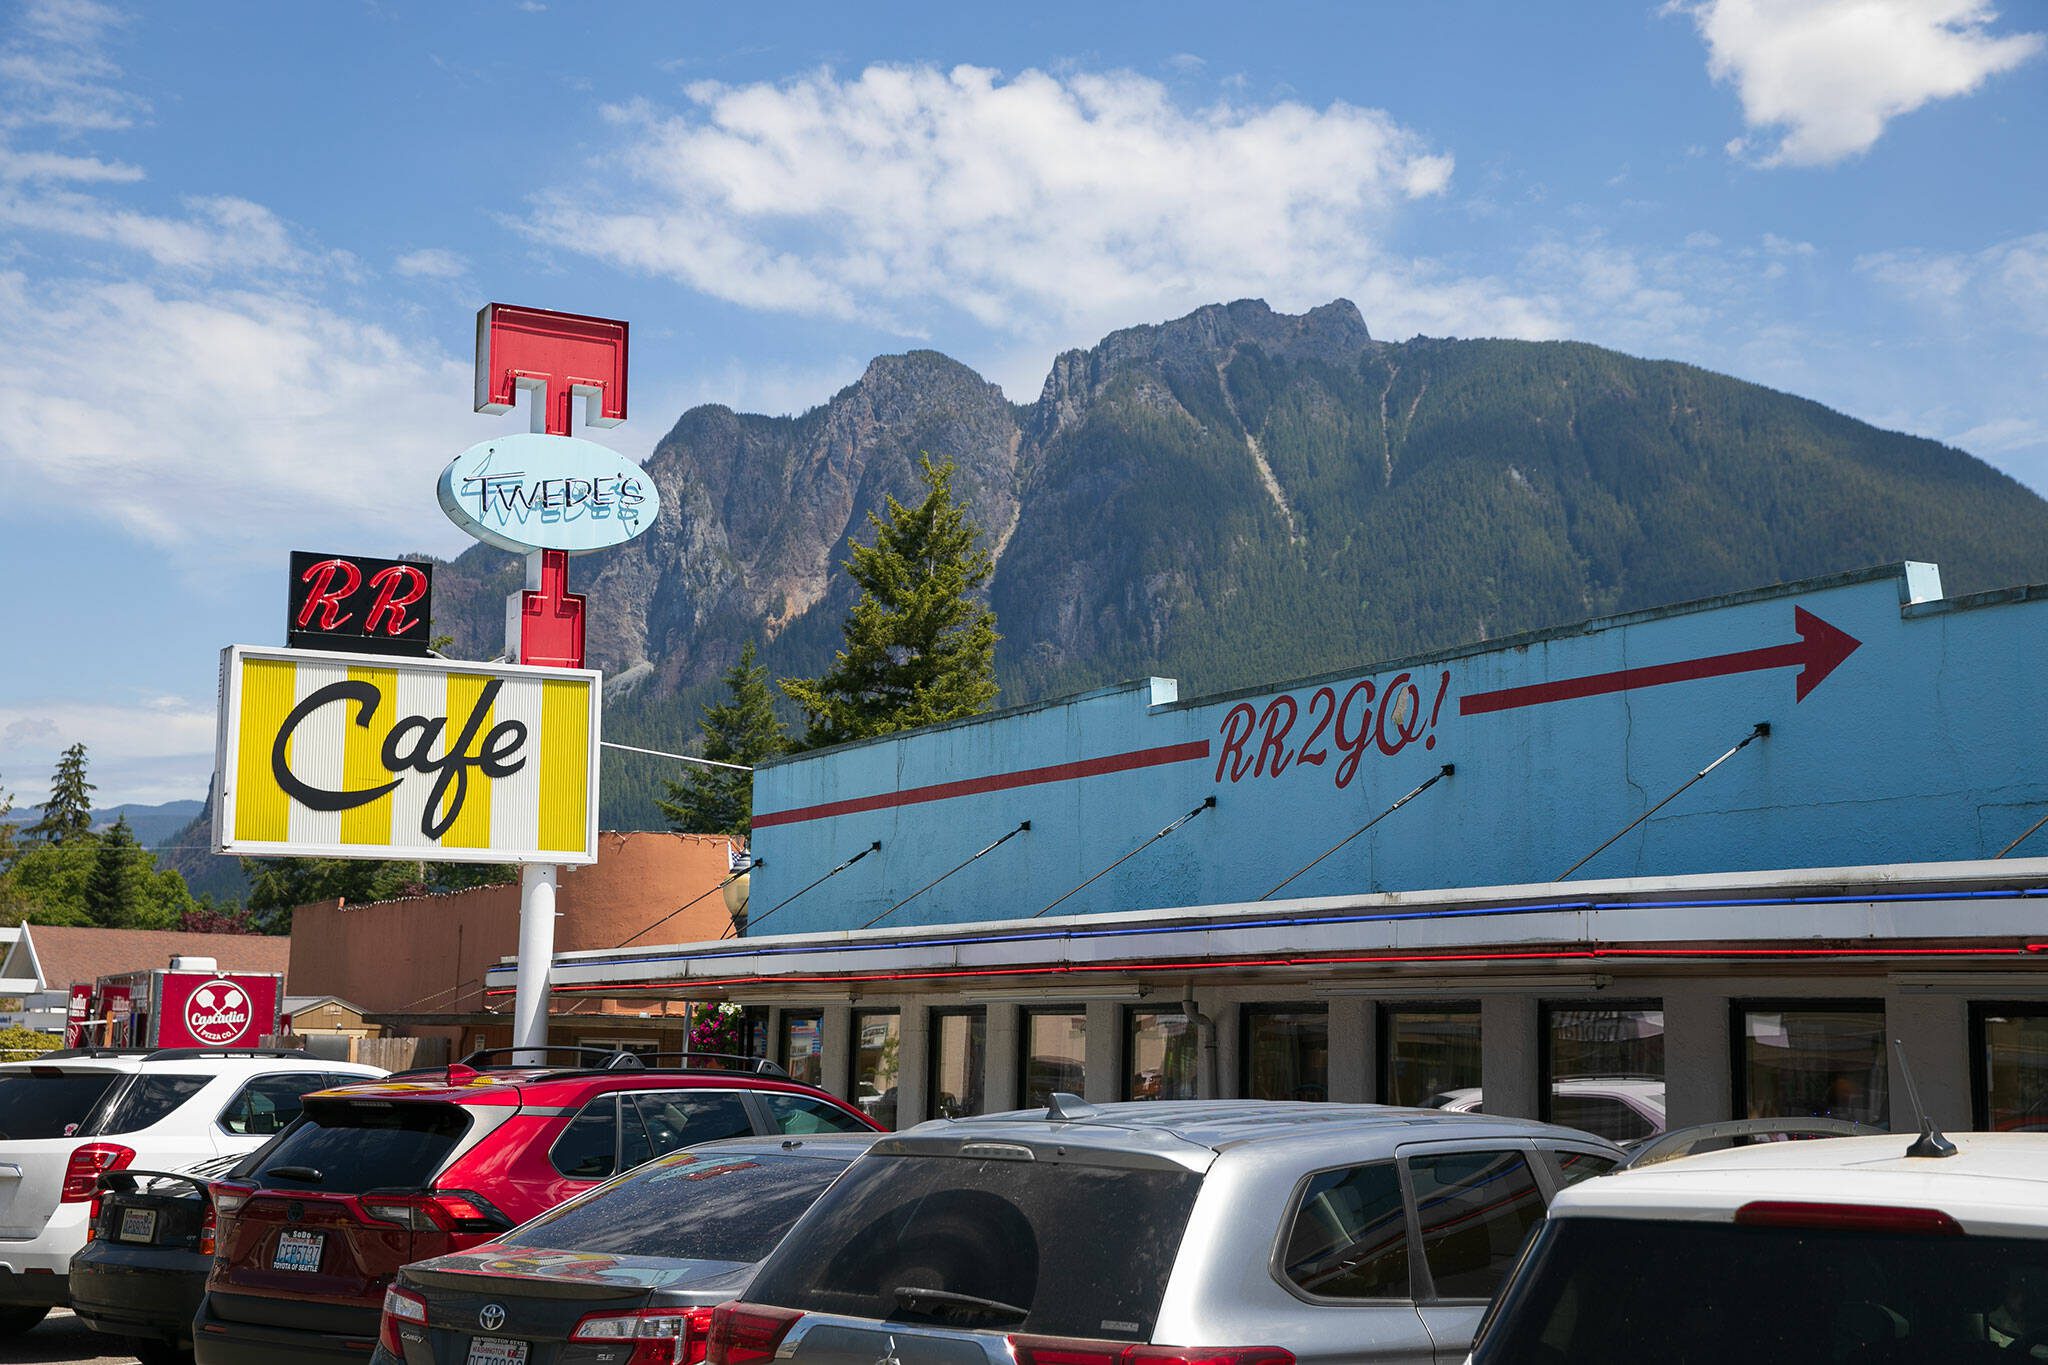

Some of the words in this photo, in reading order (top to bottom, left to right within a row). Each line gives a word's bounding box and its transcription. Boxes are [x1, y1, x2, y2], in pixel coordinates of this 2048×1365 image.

[463, 471, 646, 512] TWEDE'S
[296, 559, 428, 636] RR
[1215, 670, 1450, 790] RR2GO!
[271, 679, 528, 841] Cafe
[191, 1010, 246, 1025] Cascadia
[200, 1029, 221, 1040] PIZZA
[298, 1263, 319, 1273] SEATTLE
